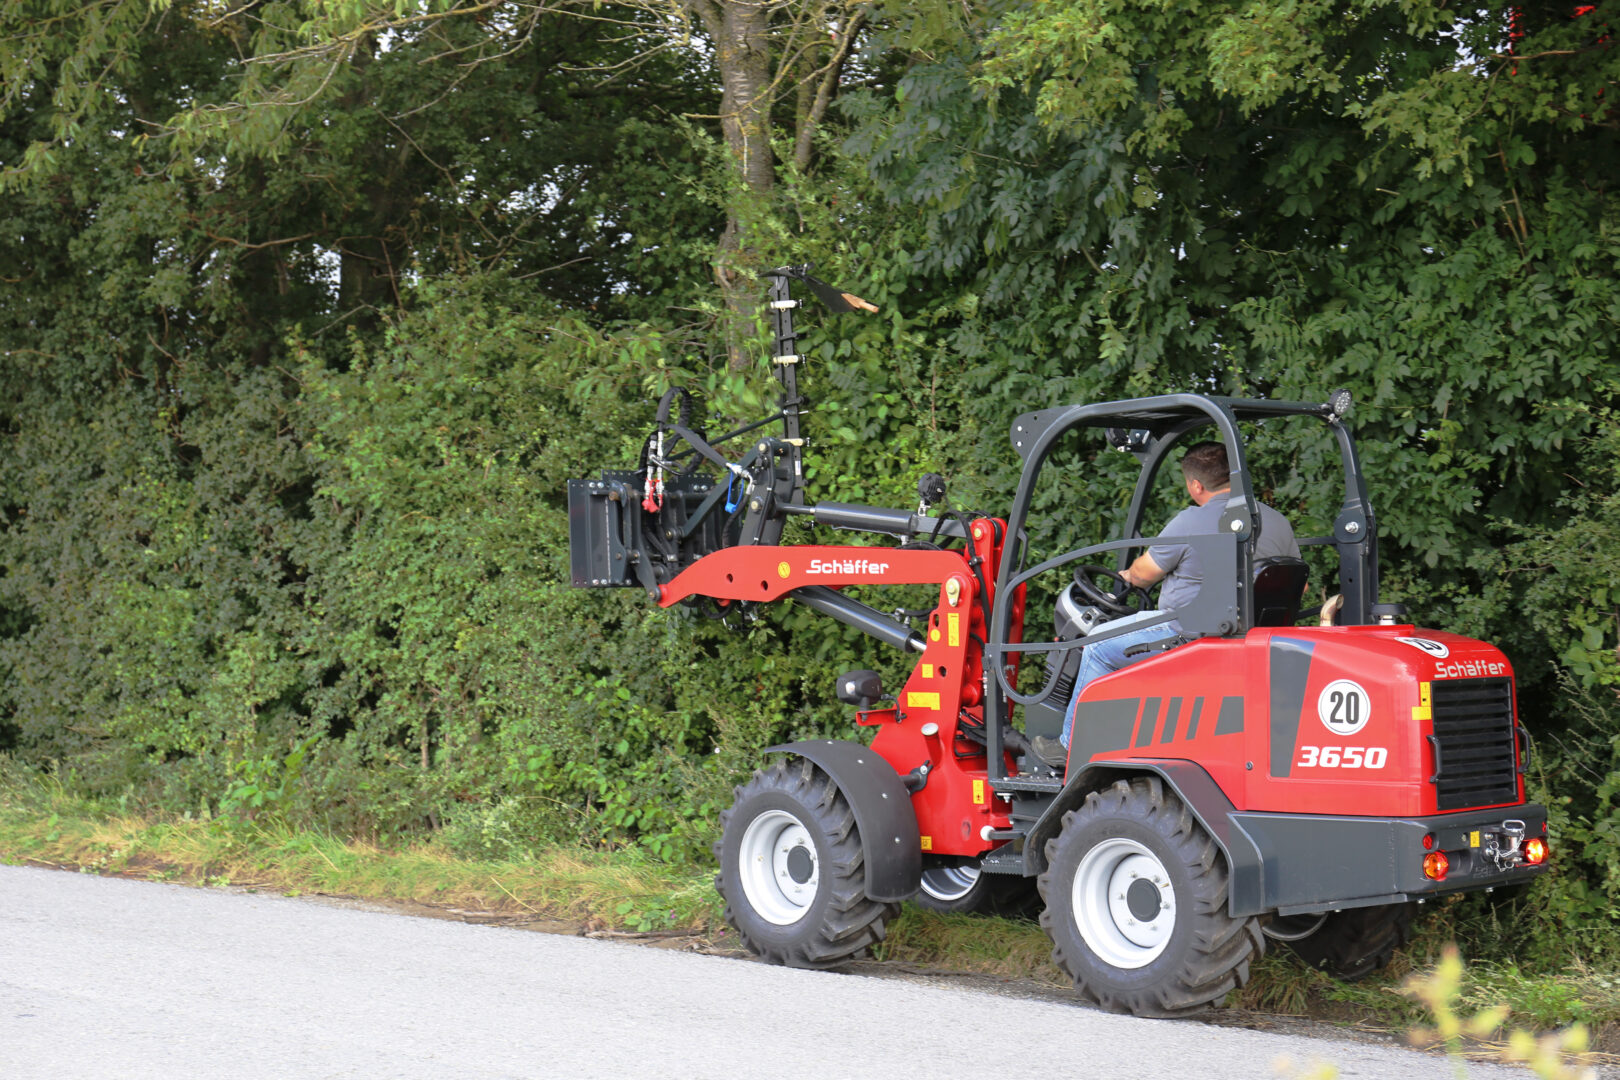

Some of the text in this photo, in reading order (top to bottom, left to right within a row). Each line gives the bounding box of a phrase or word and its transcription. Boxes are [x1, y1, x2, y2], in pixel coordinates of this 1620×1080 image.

[806, 559, 889, 574] Schäffer
[1434, 660, 1506, 678] Schäffer
[1329, 691, 1360, 725] 20
[1298, 746, 1388, 769] 3650
